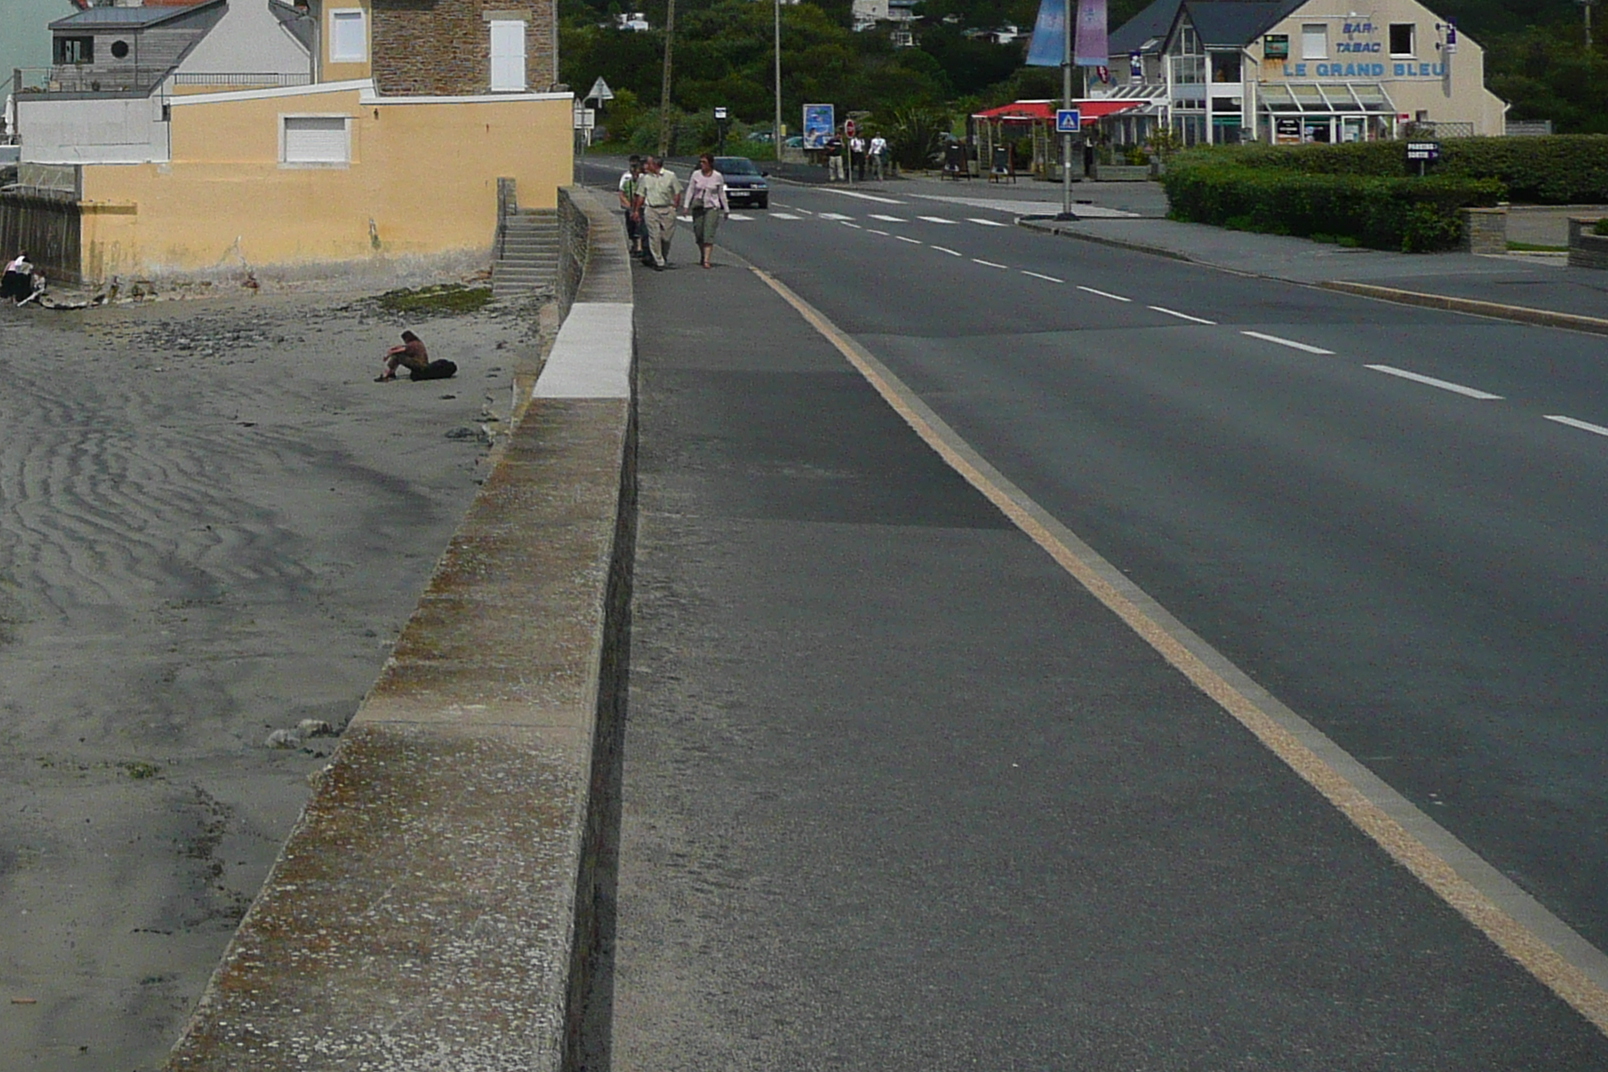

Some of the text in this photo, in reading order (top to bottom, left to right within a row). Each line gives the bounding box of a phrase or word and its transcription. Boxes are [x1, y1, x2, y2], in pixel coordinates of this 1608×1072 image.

[1335, 42, 1381, 53] TABAC
[1283, 63, 1445, 76] LE GRAND BLEU
